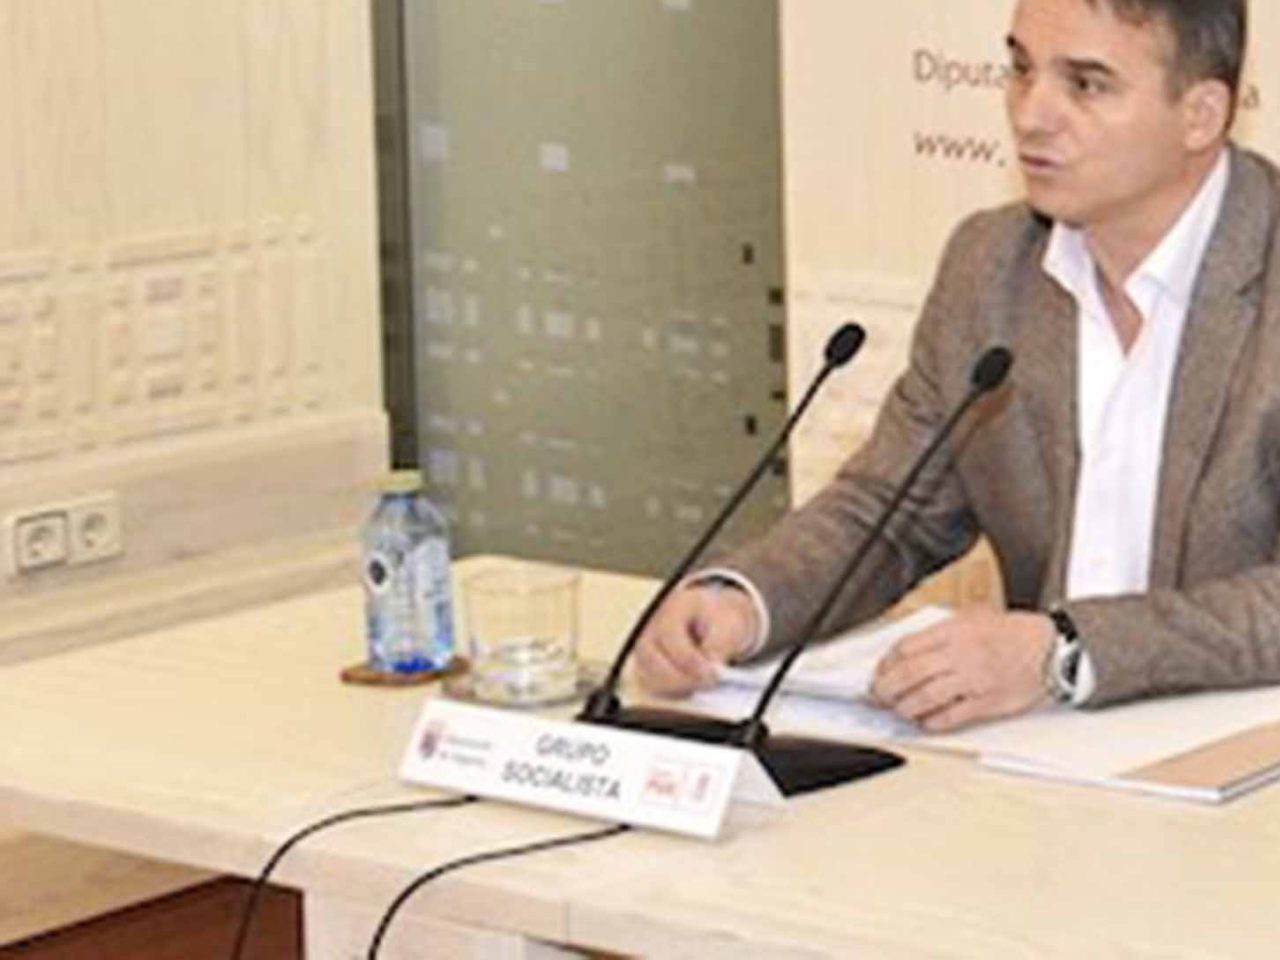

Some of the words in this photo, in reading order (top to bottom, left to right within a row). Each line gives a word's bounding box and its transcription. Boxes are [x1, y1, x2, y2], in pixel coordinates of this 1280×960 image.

[913, 130, 1006, 168] www.
[534, 733, 611, 767] GRUPO
[500, 757, 621, 800] SOCIALISTA
